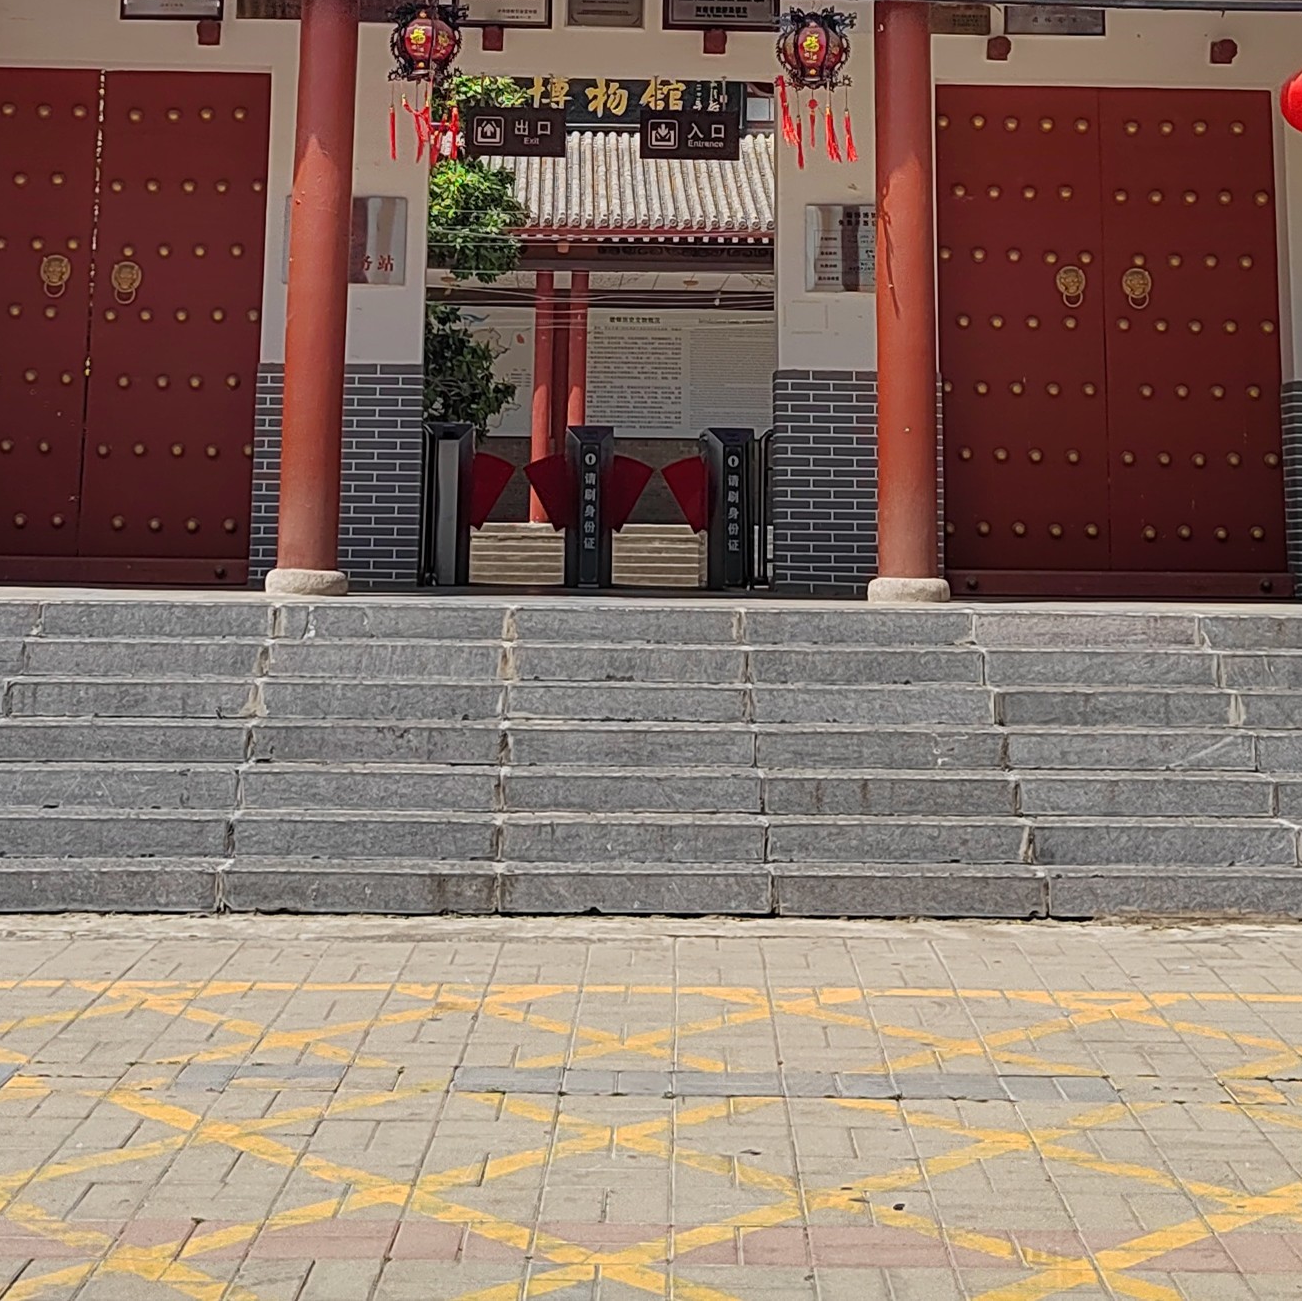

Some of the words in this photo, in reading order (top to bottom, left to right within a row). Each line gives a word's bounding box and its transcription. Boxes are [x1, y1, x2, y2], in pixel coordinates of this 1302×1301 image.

[514, 120, 552, 136] 出口
[687, 123, 726, 139] 入口
[523, 137, 540, 145] Exit
[687, 140, 725, 148] Entrance
[583, 472, 597, 550] 请刷身份证
[727, 474, 740, 552] 请刷身份证
